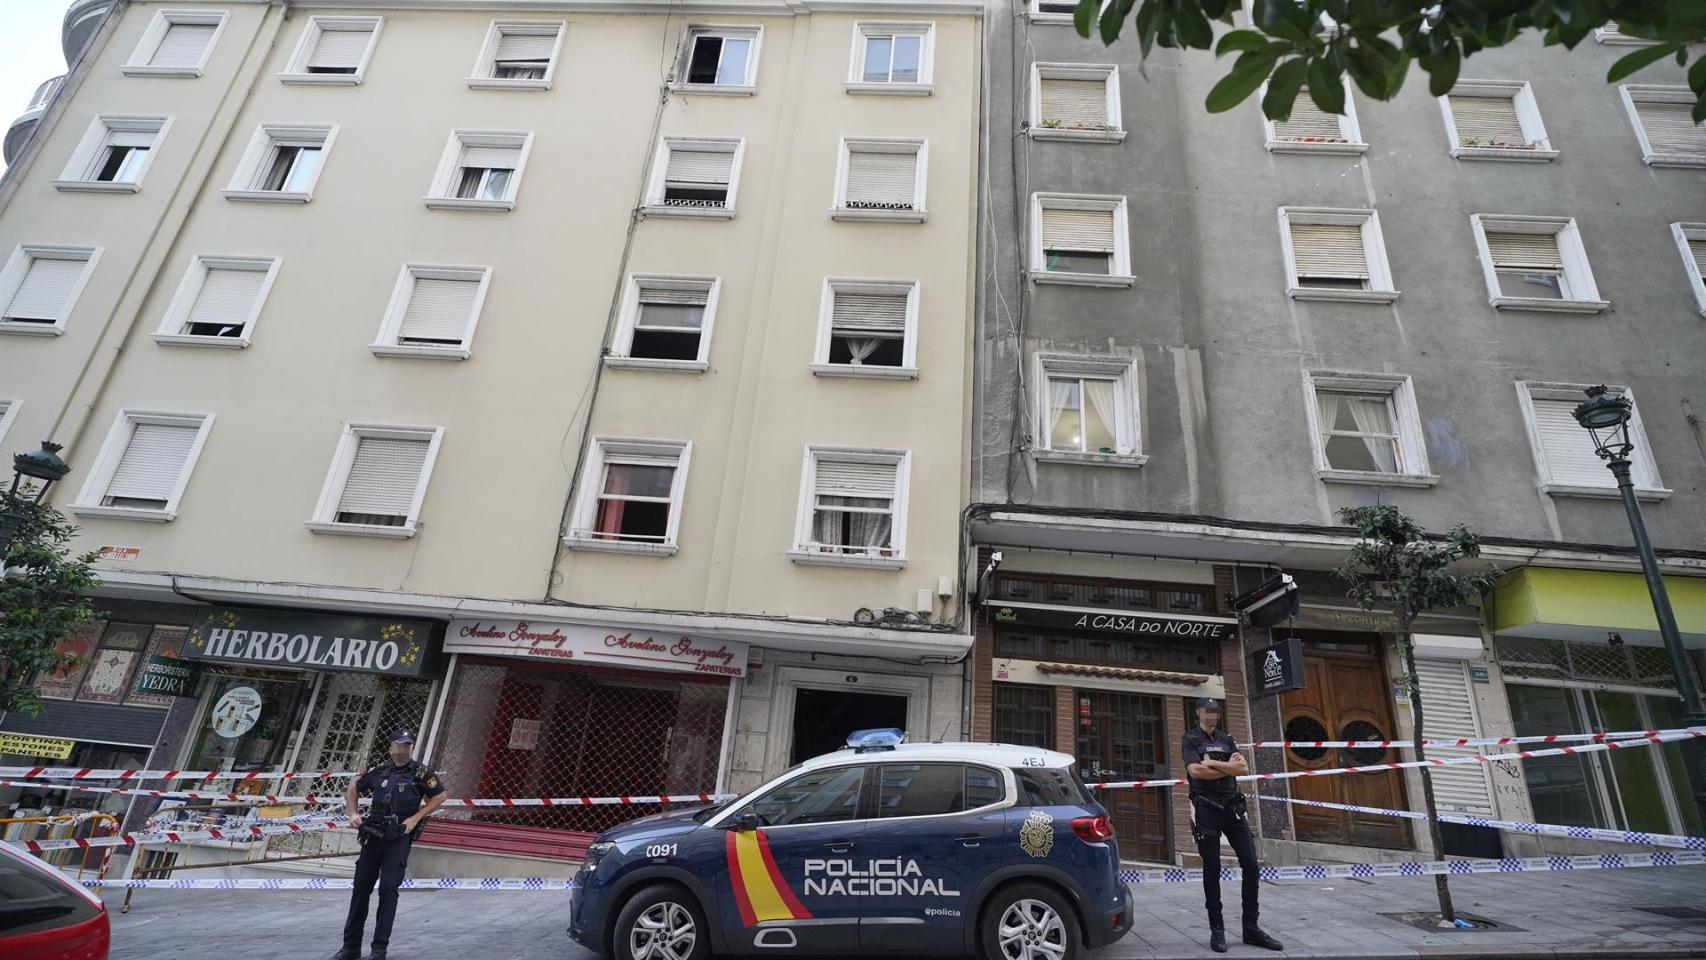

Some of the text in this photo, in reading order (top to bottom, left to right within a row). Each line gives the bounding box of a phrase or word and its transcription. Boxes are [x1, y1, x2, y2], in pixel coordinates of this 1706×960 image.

[1074, 614, 1088, 627] A
[1092, 615, 1136, 631] CASA
[1163, 621, 1225, 637] NORTE
[203, 628, 399, 670] HERBOLARIO
[604, 633, 667, 653] Avelino
[527, 647, 574, 658] ZAPATERIAS
[694, 663, 742, 675] ZAPATERIAS
[142, 674, 184, 695] YEDRA
[2, 734, 72, 746] CORTINAS
[2, 741, 65, 752] ESTORES
[0, 747, 62, 758] PANELES
[1022, 757, 1046, 767] 4EJ
[804, 856, 922, 877] POLICÍA
[804, 878, 961, 896] NACIONAL
